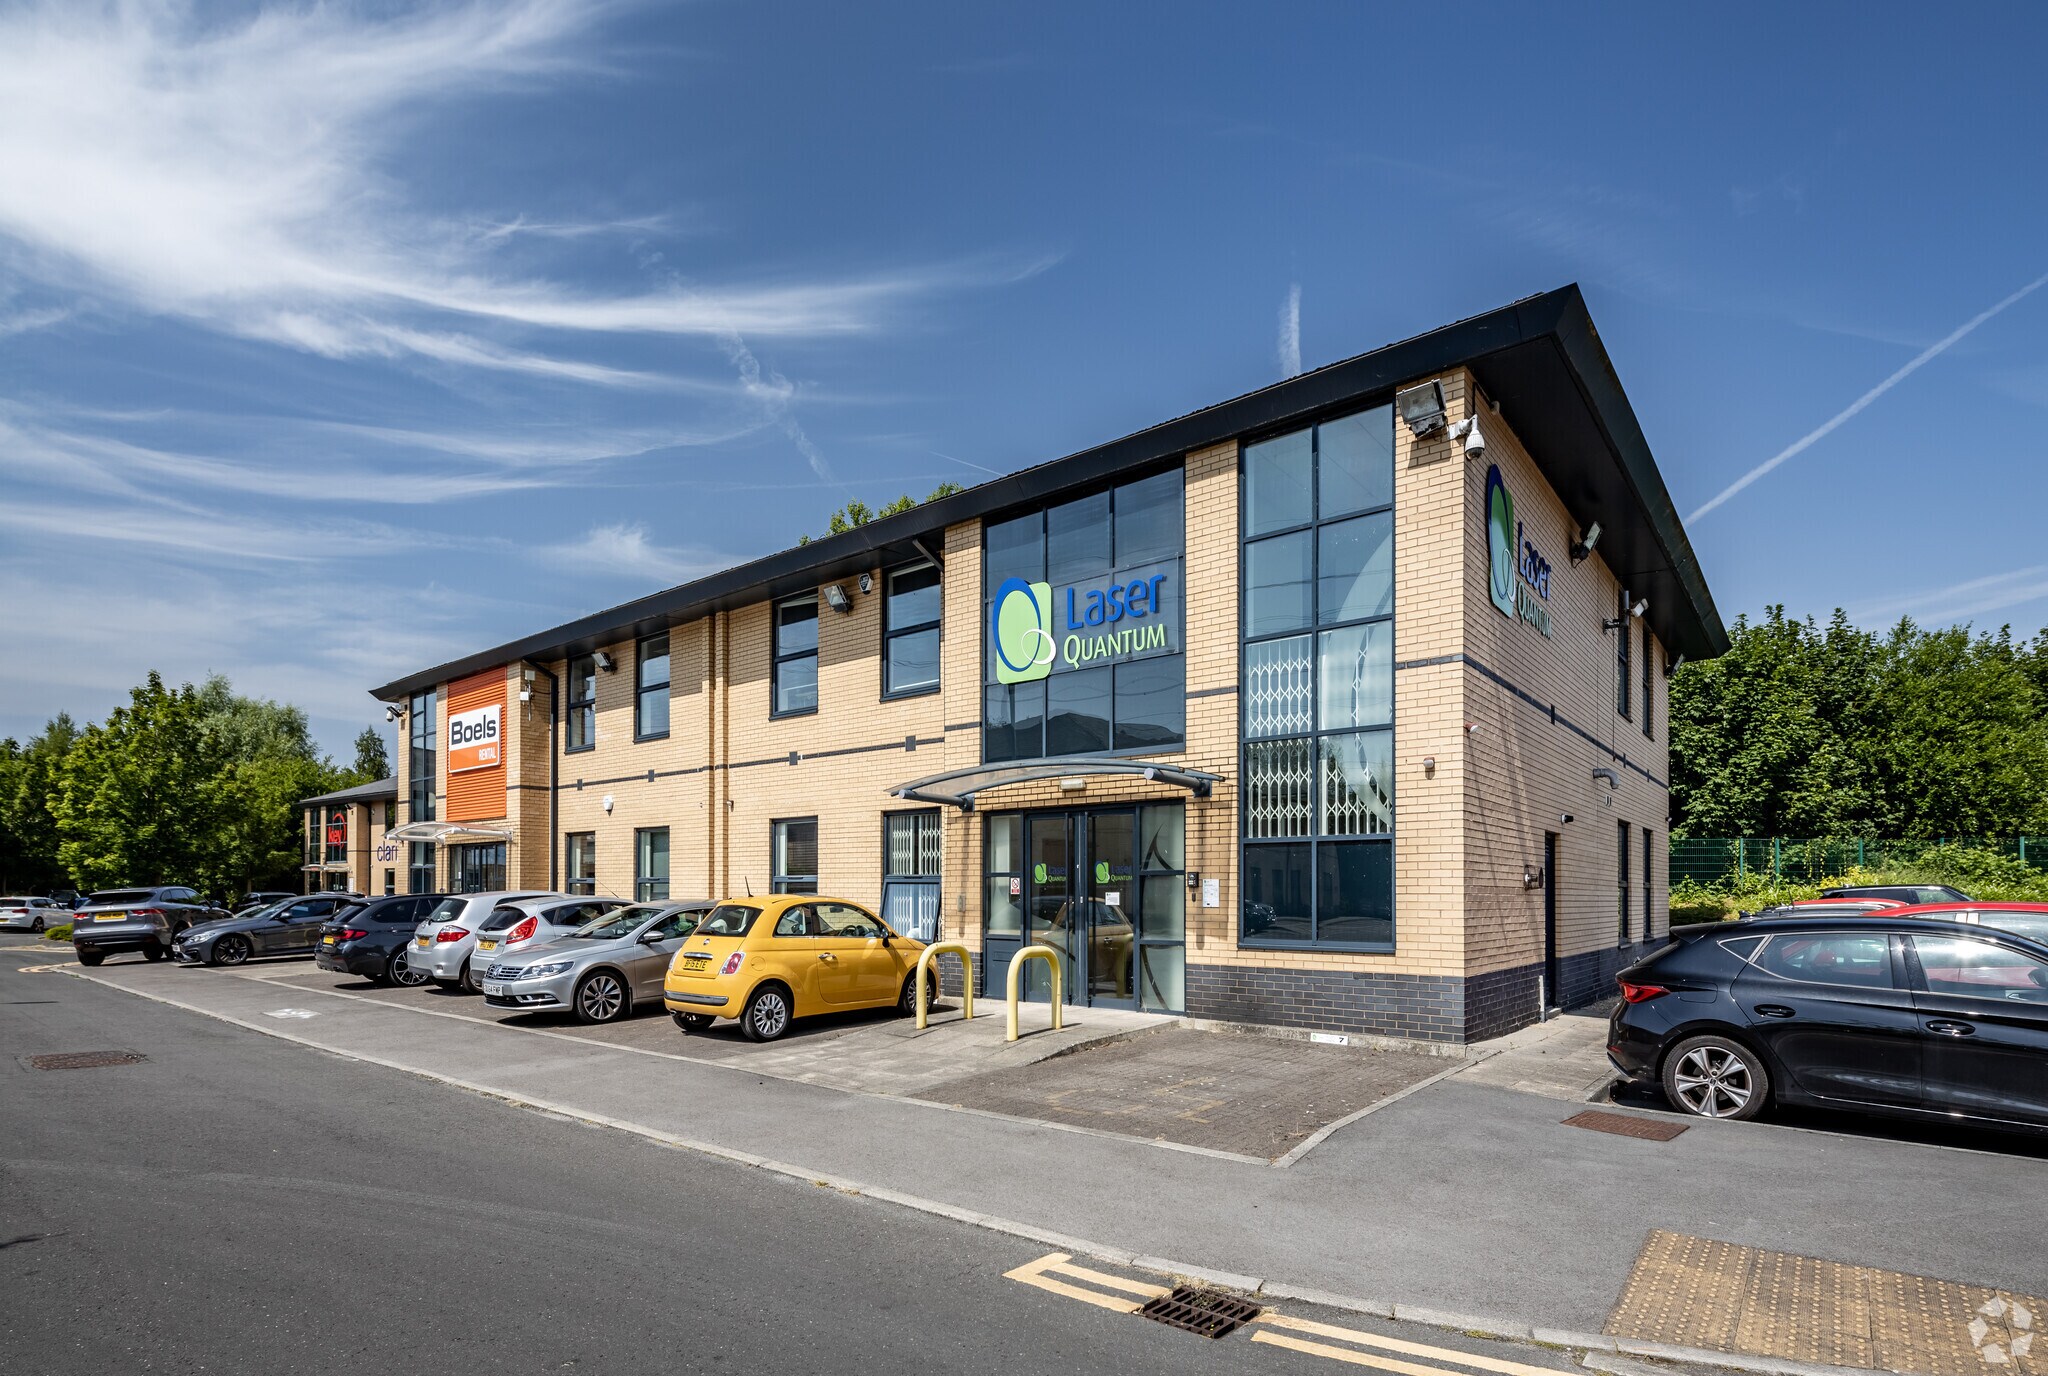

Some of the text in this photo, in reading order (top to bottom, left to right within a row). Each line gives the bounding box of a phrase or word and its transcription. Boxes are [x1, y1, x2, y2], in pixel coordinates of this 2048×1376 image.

[1518, 520, 1552, 601] Laser
[1067, 574, 1165, 630] Laser
[1517, 581, 1552, 641] QUANTUM
[1063, 623, 1166, 670] QUANTUM
[451, 714, 497, 745] Boels
[478, 747, 496, 761] RENTAL
[1111, 875, 1132, 883] QUANTUM
